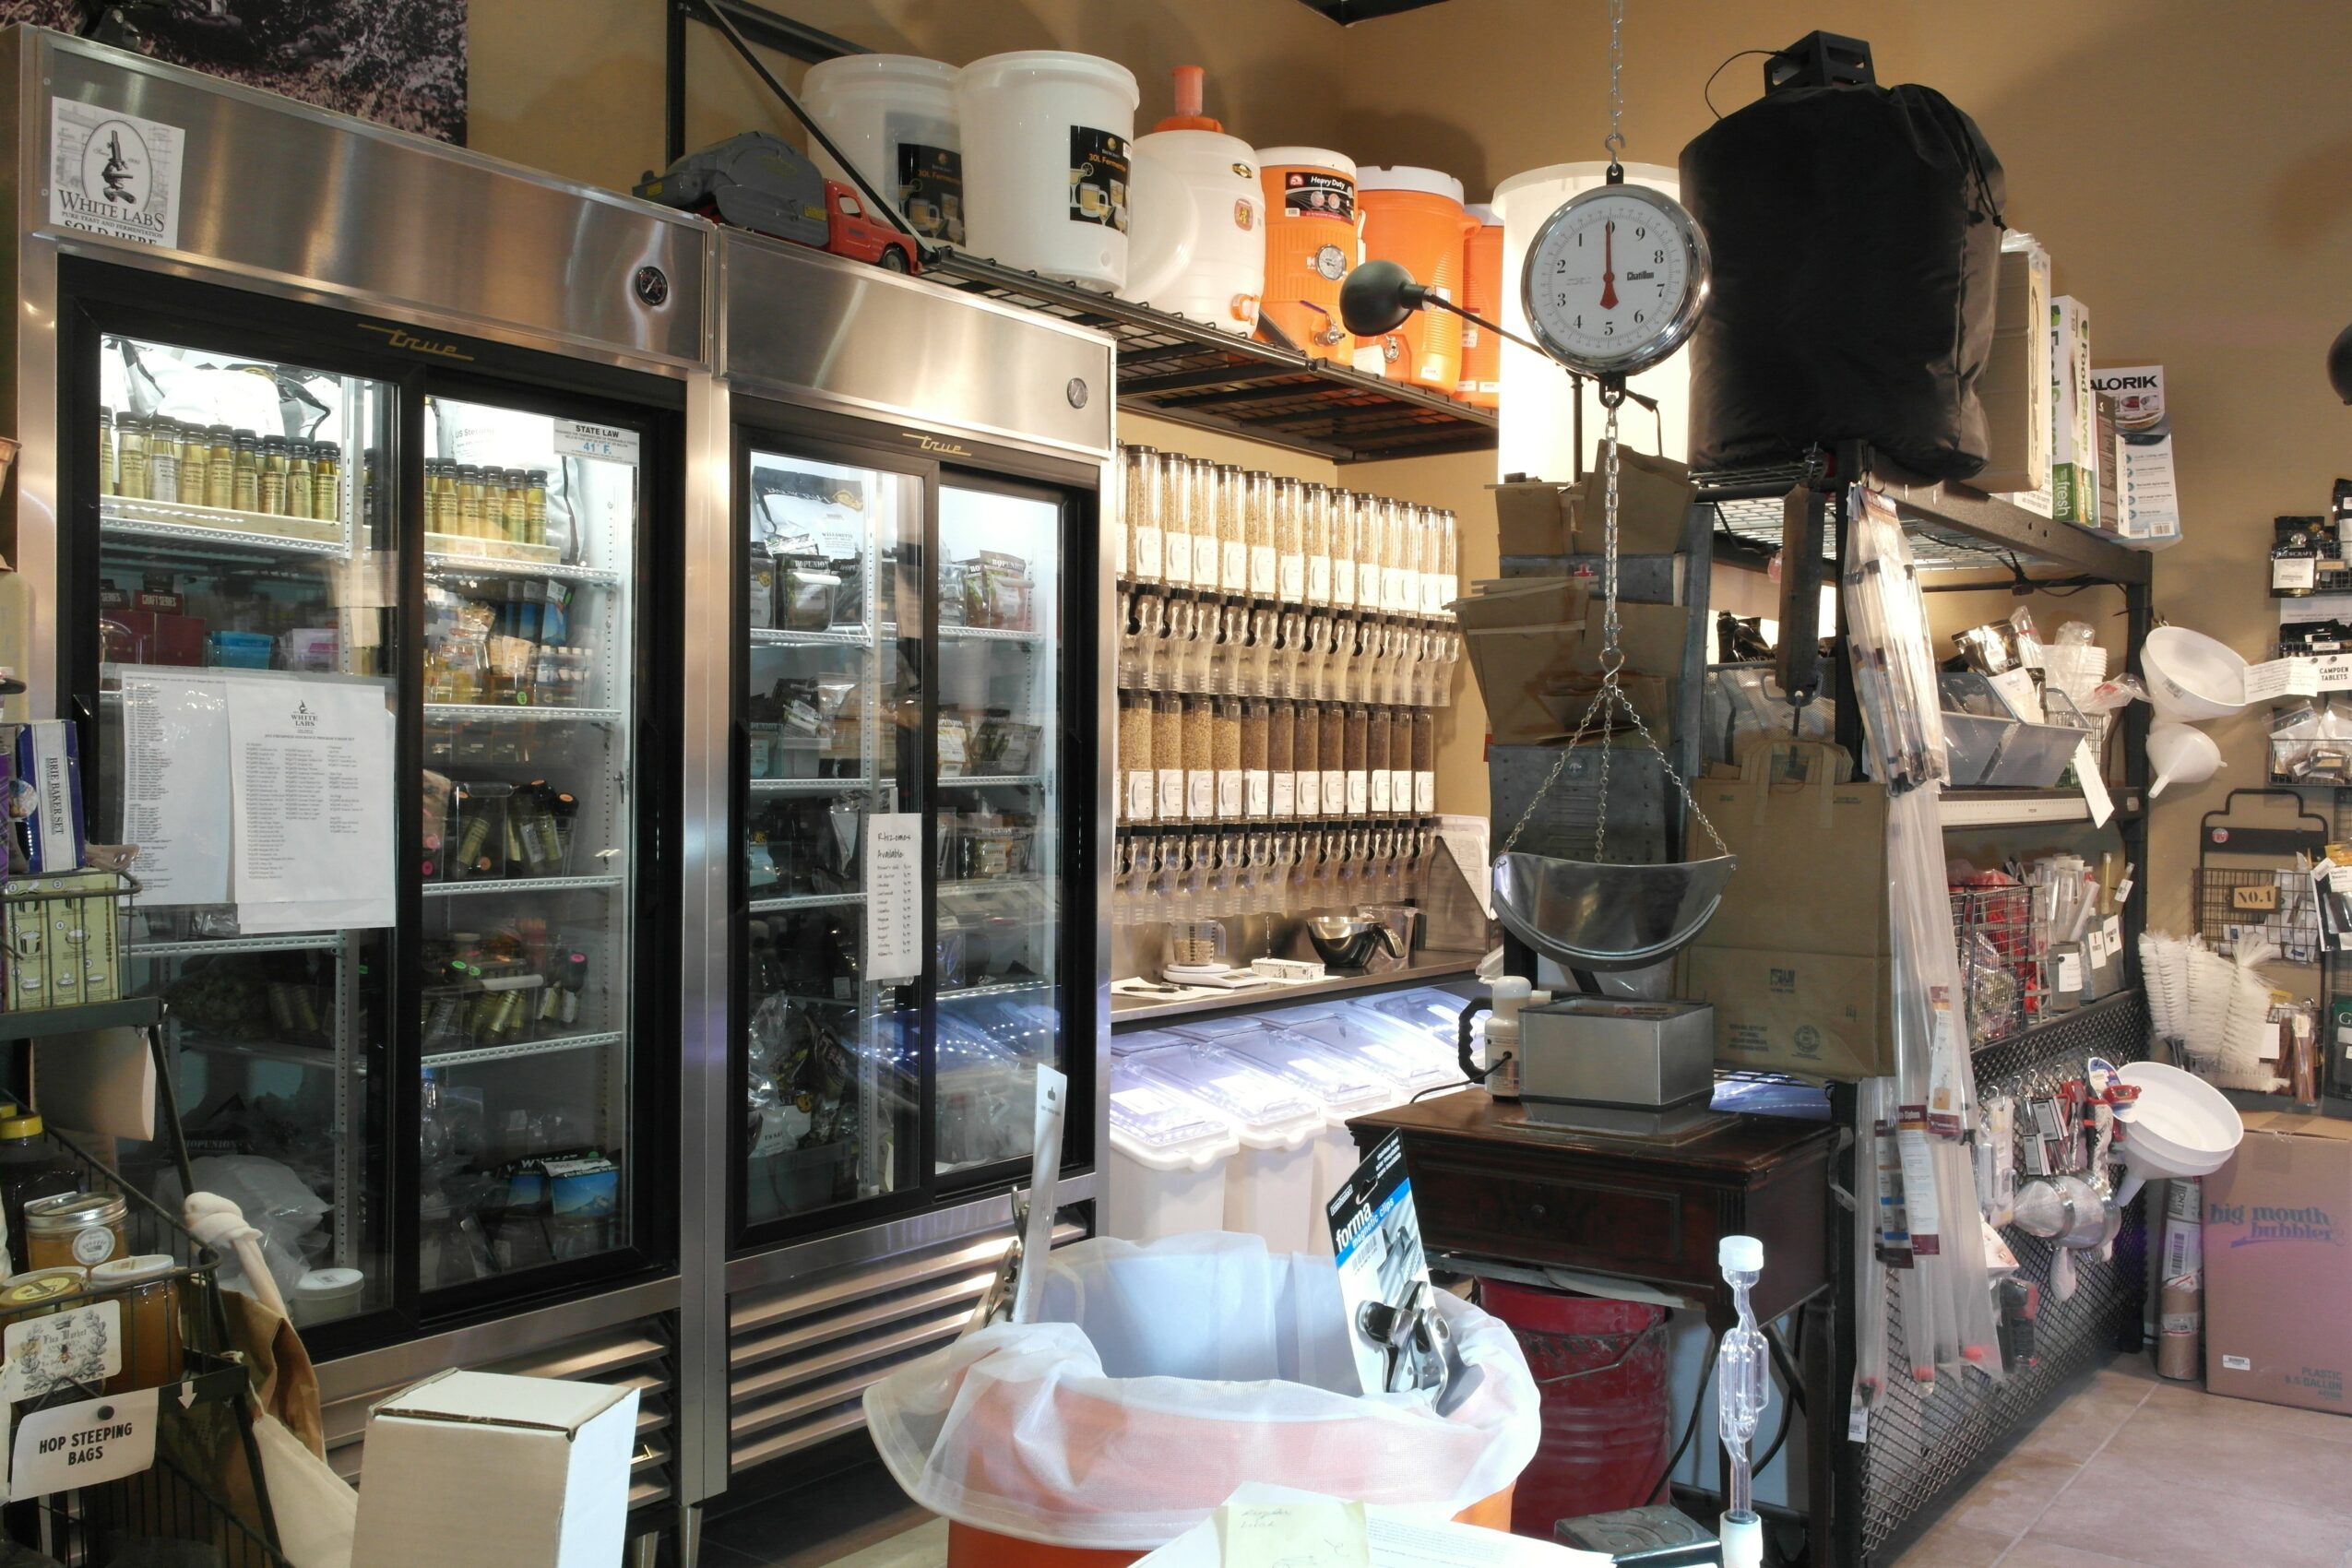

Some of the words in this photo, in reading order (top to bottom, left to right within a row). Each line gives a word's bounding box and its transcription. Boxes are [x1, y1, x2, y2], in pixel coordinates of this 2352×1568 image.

[1310, 175, 1331, 187] Heavy
[1330, 179, 1346, 190] Duty
[58, 189, 118, 219] WHITE
[123, 208, 166, 232] LABS
[62, 211, 80, 221] PURE
[81, 215, 101, 225] YEAST
[101, 220, 115, 228] AND
[116, 222, 164, 239] FERMENTATION
[1578, 232, 1583, 247] 1
[1635, 226, 1645, 241] 9
[1654, 249, 1664, 265] 8
[1556, 259, 1566, 274] 2
[1657, 283, 1665, 298] 7
[1557, 292, 1566, 308] 3
[1573, 315, 1583, 329] 4
[1633, 309, 1645, 324] 6
[1604, 321, 1614, 336] 5
[576, 424, 600, 435] STATE
[602, 429, 620, 438] LAW
[2059, 481, 2071, 517] fresh
[2319, 666, 2349, 675] CAMPDEN
[49, 757, 60, 782] BRIE
[52, 783, 63, 817] BAKER
[55, 817, 65, 835] SET
[877, 849, 904, 858] Available
[2238, 890, 2273, 905] NO.1
[2209, 1203, 2244, 1227] big
[2251, 1205, 2331, 1226] mouth
[1336, 1202, 1373, 1253] forma
[1352, 1214, 1379, 1249] magnetic
[1379, 1197, 1395, 1218] clips
[2301, 1366, 2343, 1381] PLASTIC
[39, 1436, 66, 1455] HOP
[71, 1422, 133, 1447] STEEPING
[68, 1445, 103, 1467] BAGS
